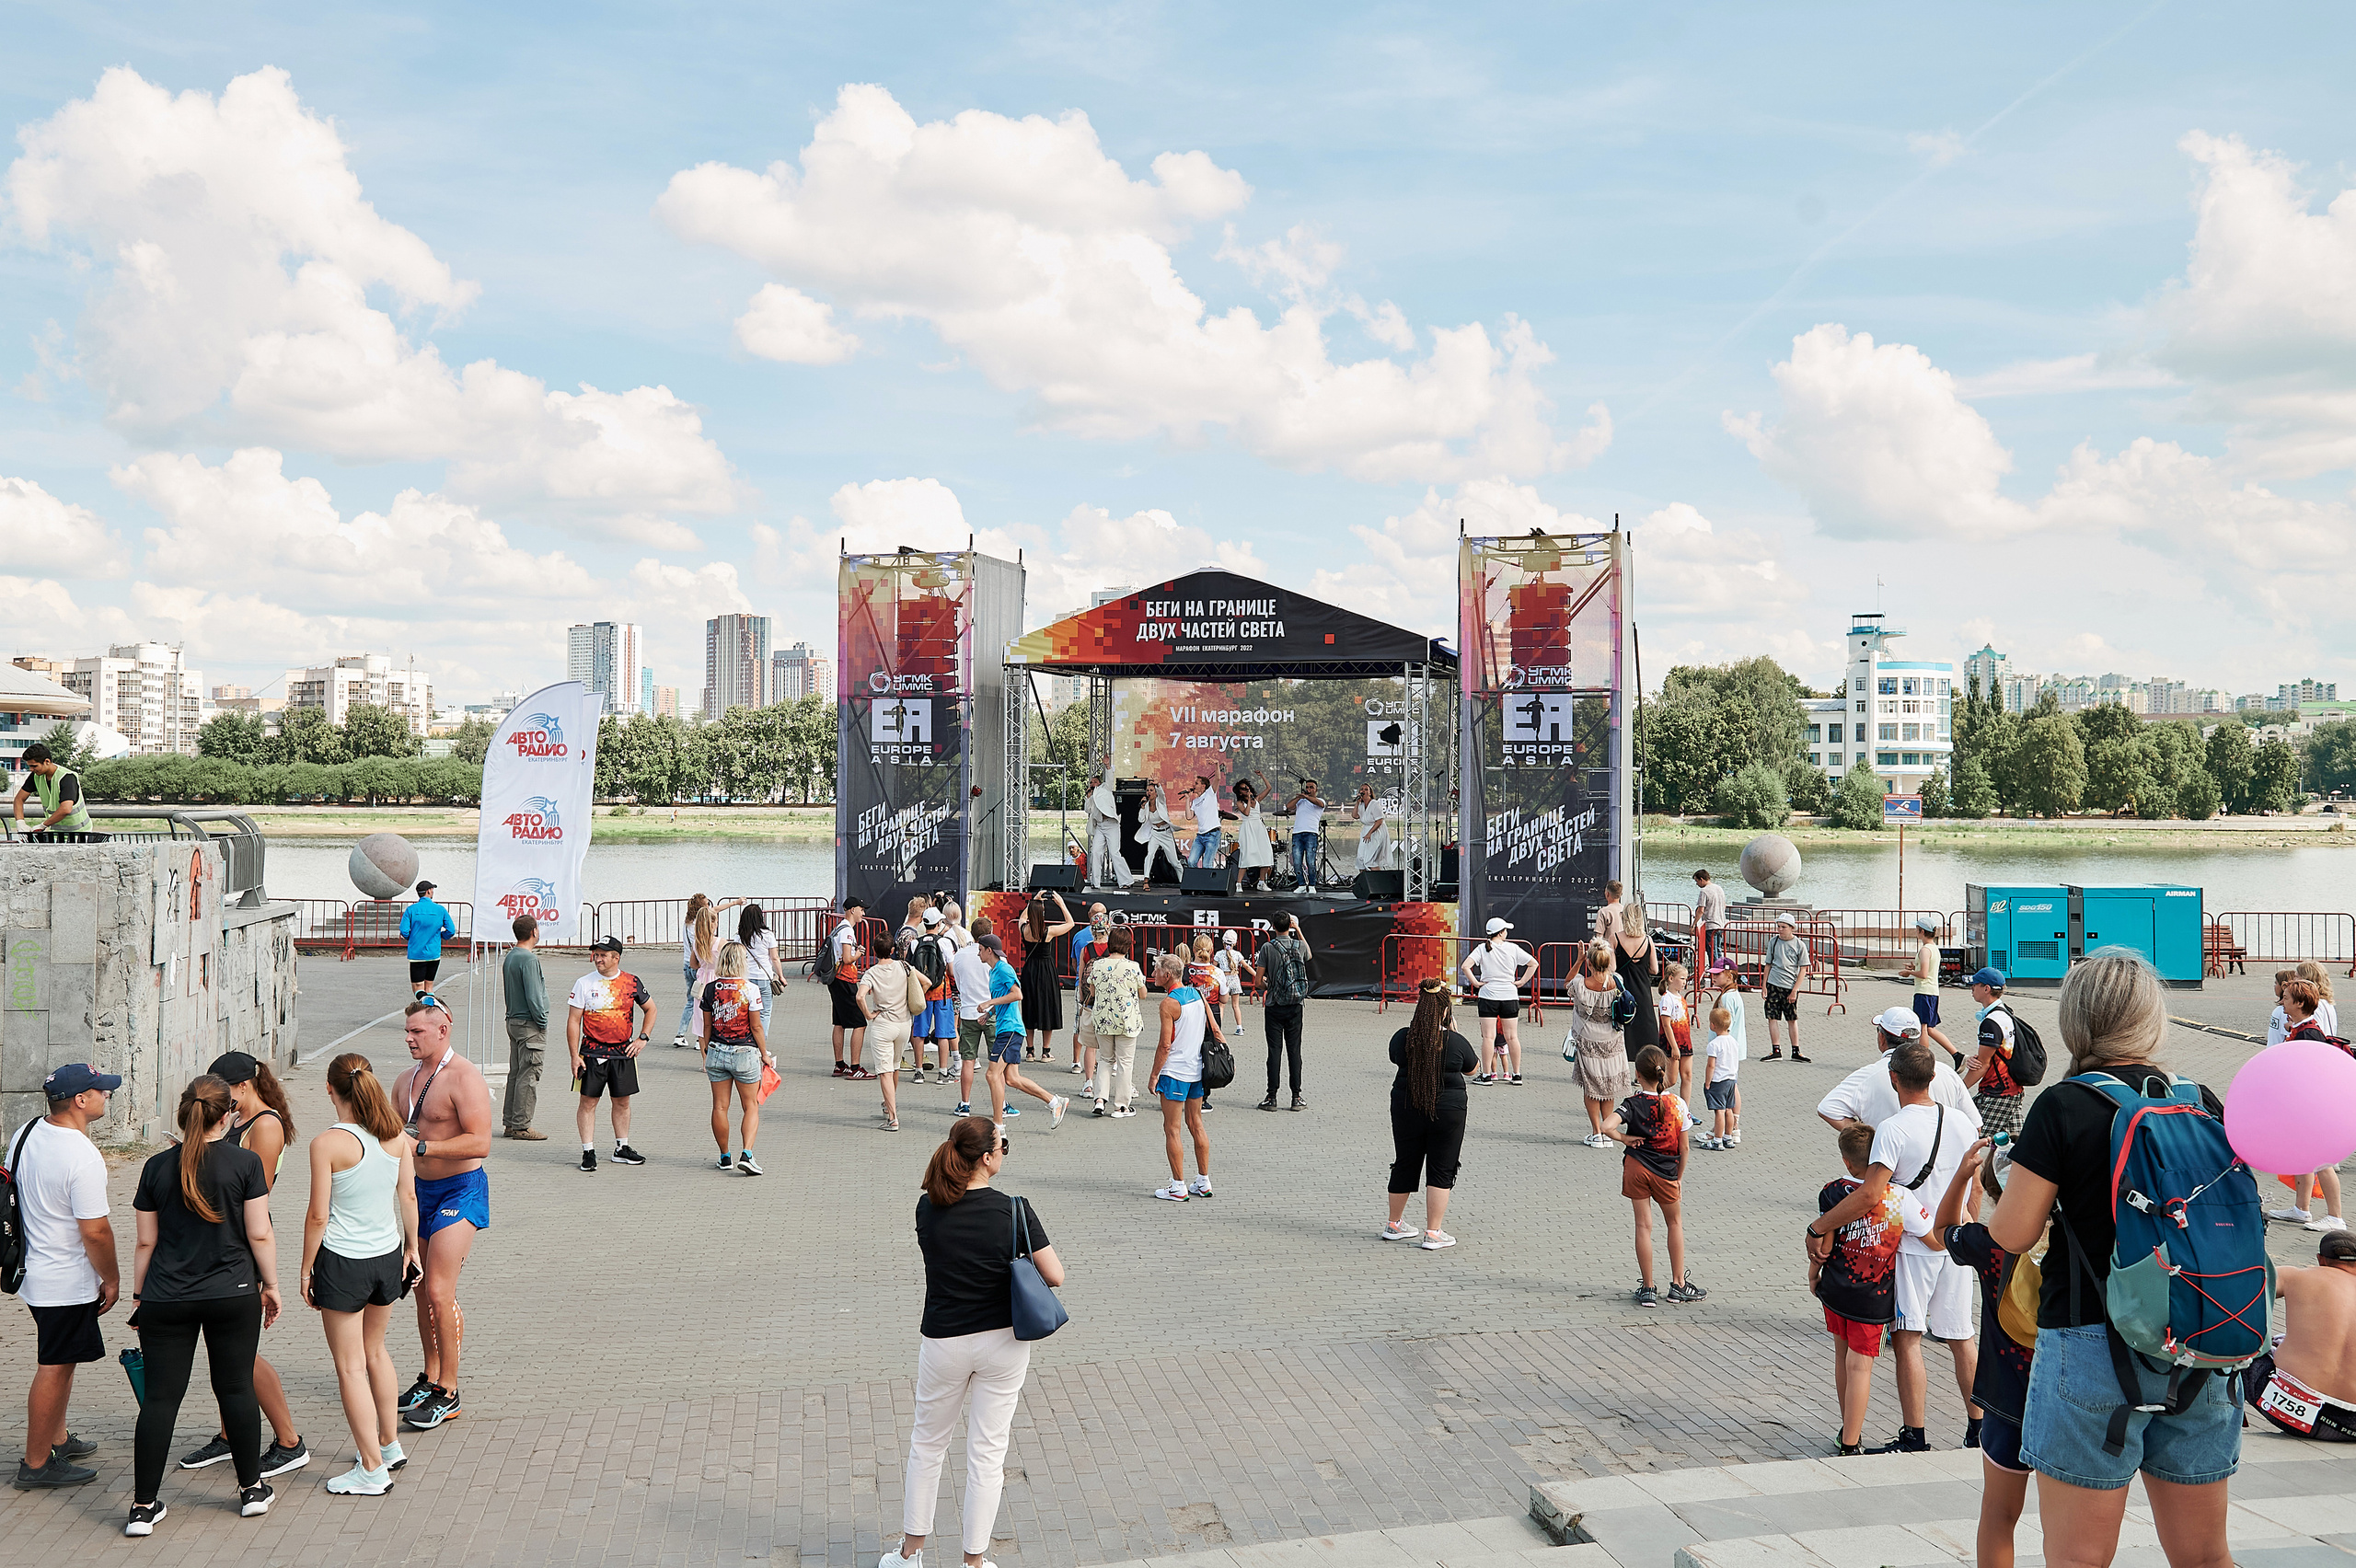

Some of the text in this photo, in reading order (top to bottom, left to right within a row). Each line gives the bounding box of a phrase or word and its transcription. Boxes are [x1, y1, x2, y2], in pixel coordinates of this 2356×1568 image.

[1146, 599, 1276, 618] БЕГИ НА ГРАНИЦЕ
[1136, 618, 1286, 642] ДВУХ ЧАСТЕЙ СВЕТА
[893, 674, 933, 683] УГМК
[893, 683, 933, 691] UMMC
[1170, 706, 1295, 726] VII марафон
[505, 731, 547, 744] АВТО
[1170, 732, 1264, 753] 7 августа
[518, 744, 568, 756] РАДИО
[871, 744, 932, 755] EUROPE
[1502, 744, 1573, 755] EUROPE
[871, 755, 932, 765] ASIA
[1502, 755, 1573, 766] ASIA
[502, 813, 543, 826] АВТО
[858, 801, 886, 834] БЕГИ
[858, 800, 926, 849] НА ГРАНИЦЕ
[1486, 805, 1520, 841] БЕГИ
[513, 826, 563, 839] РАДИО
[875, 798, 950, 859] ДВУХ ЧАСТЕЙ
[1486, 804, 1565, 859] НА ГРАНИЦЕ
[1507, 802, 1595, 869] ДВУХ ЧАСТЕЙ
[902, 824, 940, 862] СВЕТА
[1537, 832, 1583, 872] СВЕТА
[1488, 875, 1562, 883] ЕКАТЕРИНБУРГ
[495, 894, 538, 908] АВТО
[2018, 903, 2053, 912] SDG150
[1130, 913, 1168, 922] УГМК
[1846, 1228, 1865, 1242] ДВУХ
[2272, 1391, 2306, 1417] 1758
[2319, 1415, 2338, 1428] RUN
